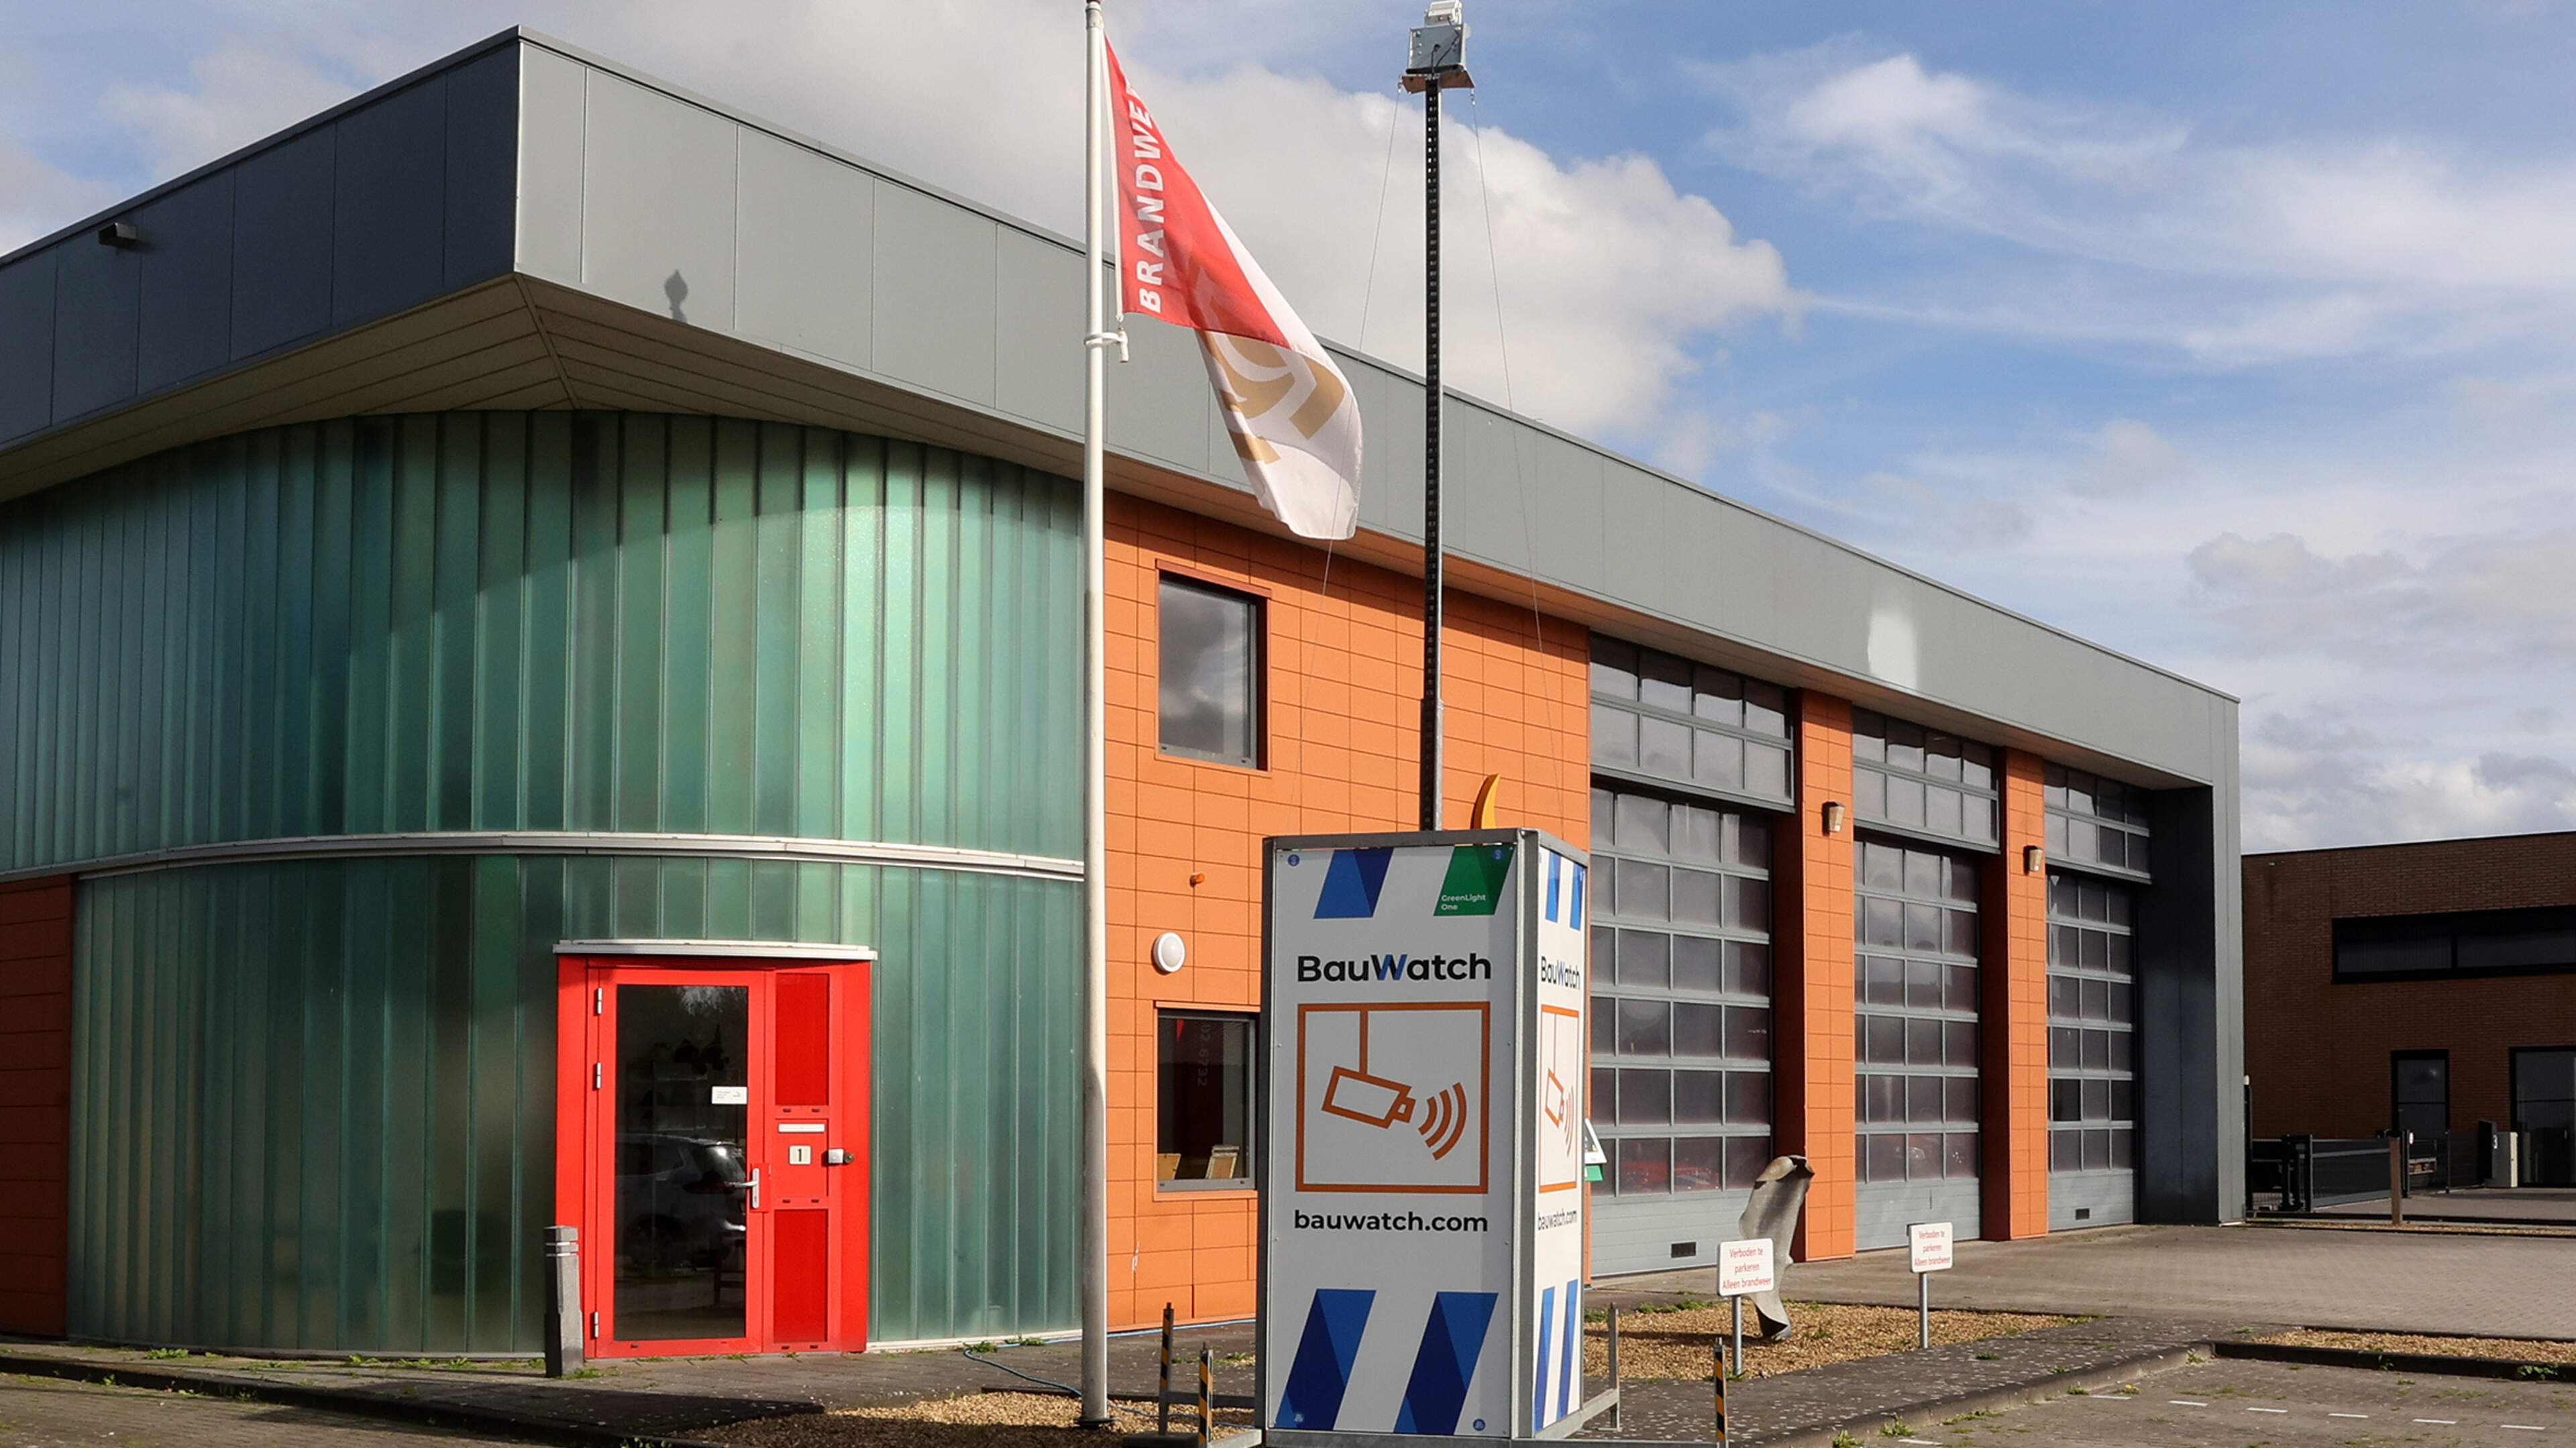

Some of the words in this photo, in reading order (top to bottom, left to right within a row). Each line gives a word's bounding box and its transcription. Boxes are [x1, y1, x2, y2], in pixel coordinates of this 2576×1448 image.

[1442, 893, 1486, 903] GreenLight
[1297, 953, 1491, 982] BauWatch
[1541, 956, 1580, 990] BauWatch
[797, 1148, 802, 1162] 1
[1294, 1210, 1488, 1232] bauwatch.com
[1729, 1247, 1756, 1258] Verboden
[1734, 1263, 1760, 1275] parkeren
